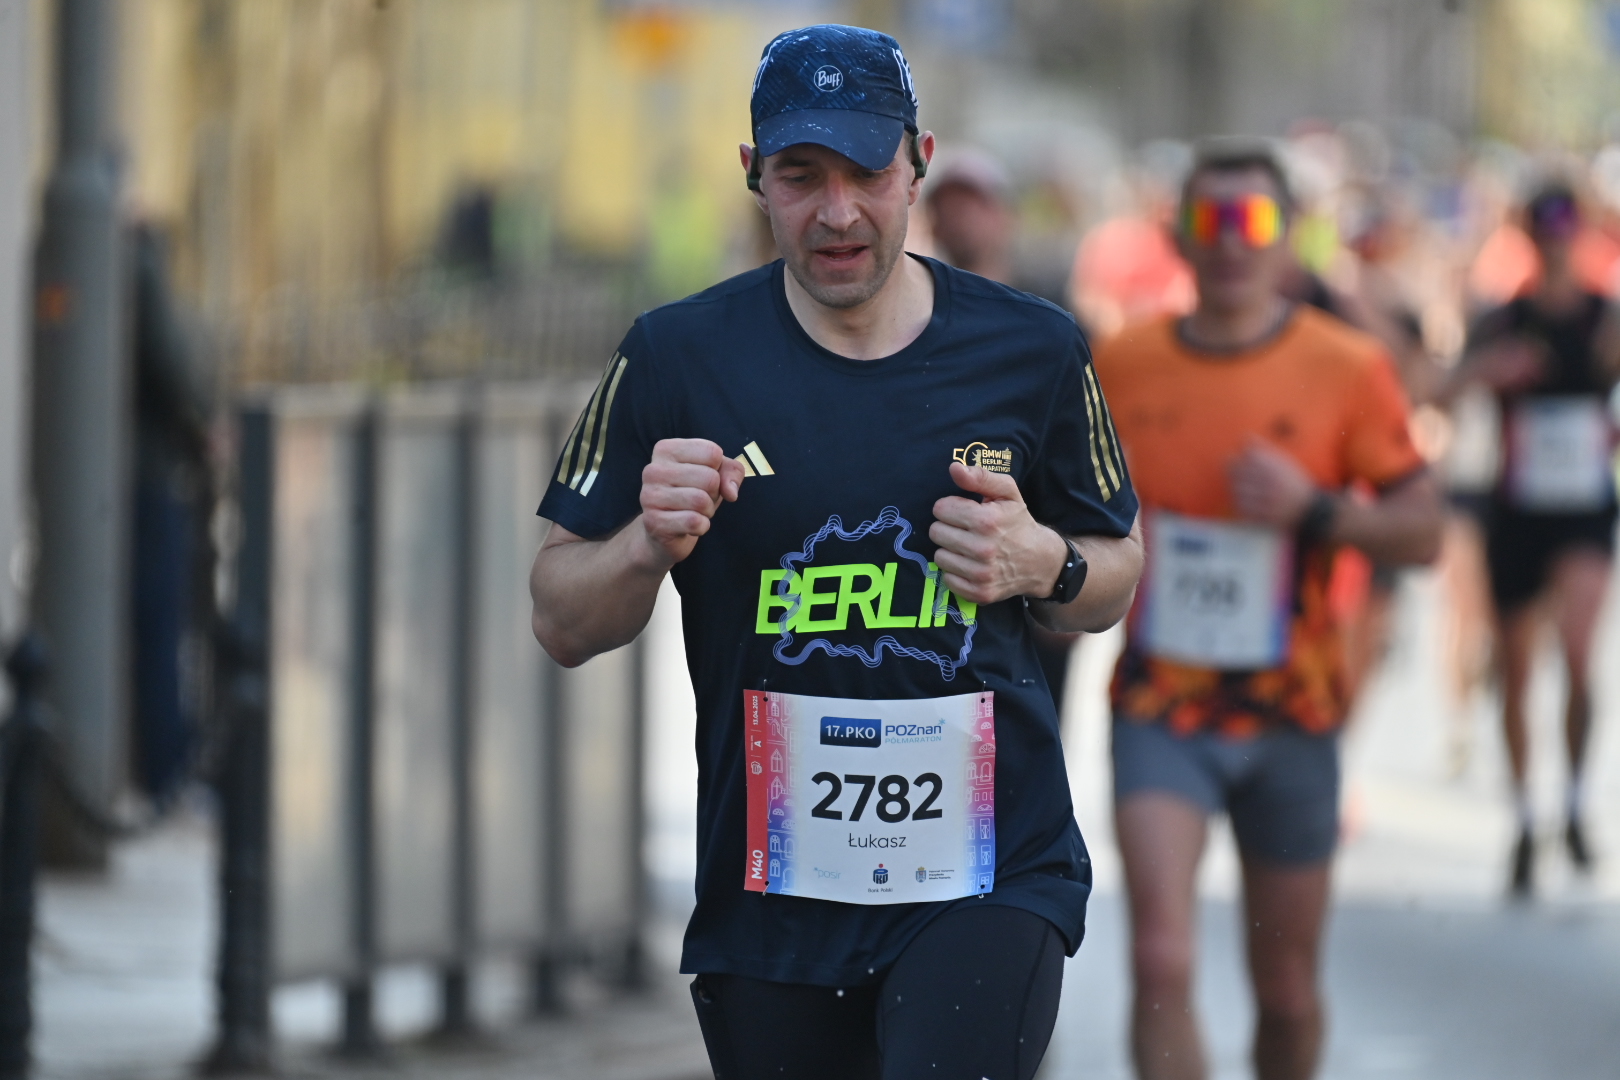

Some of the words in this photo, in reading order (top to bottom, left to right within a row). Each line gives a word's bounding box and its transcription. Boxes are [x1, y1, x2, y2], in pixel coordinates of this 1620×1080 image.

[818, 70, 841, 87] Buff
[982, 449, 1002, 459] BMW
[753, 740, 762, 748] A
[885, 735, 942, 744] PÓŁMARATON
[811, 771, 943, 823] 2782
[848, 832, 907, 849] Łukasz
[751, 849, 764, 880] M40
